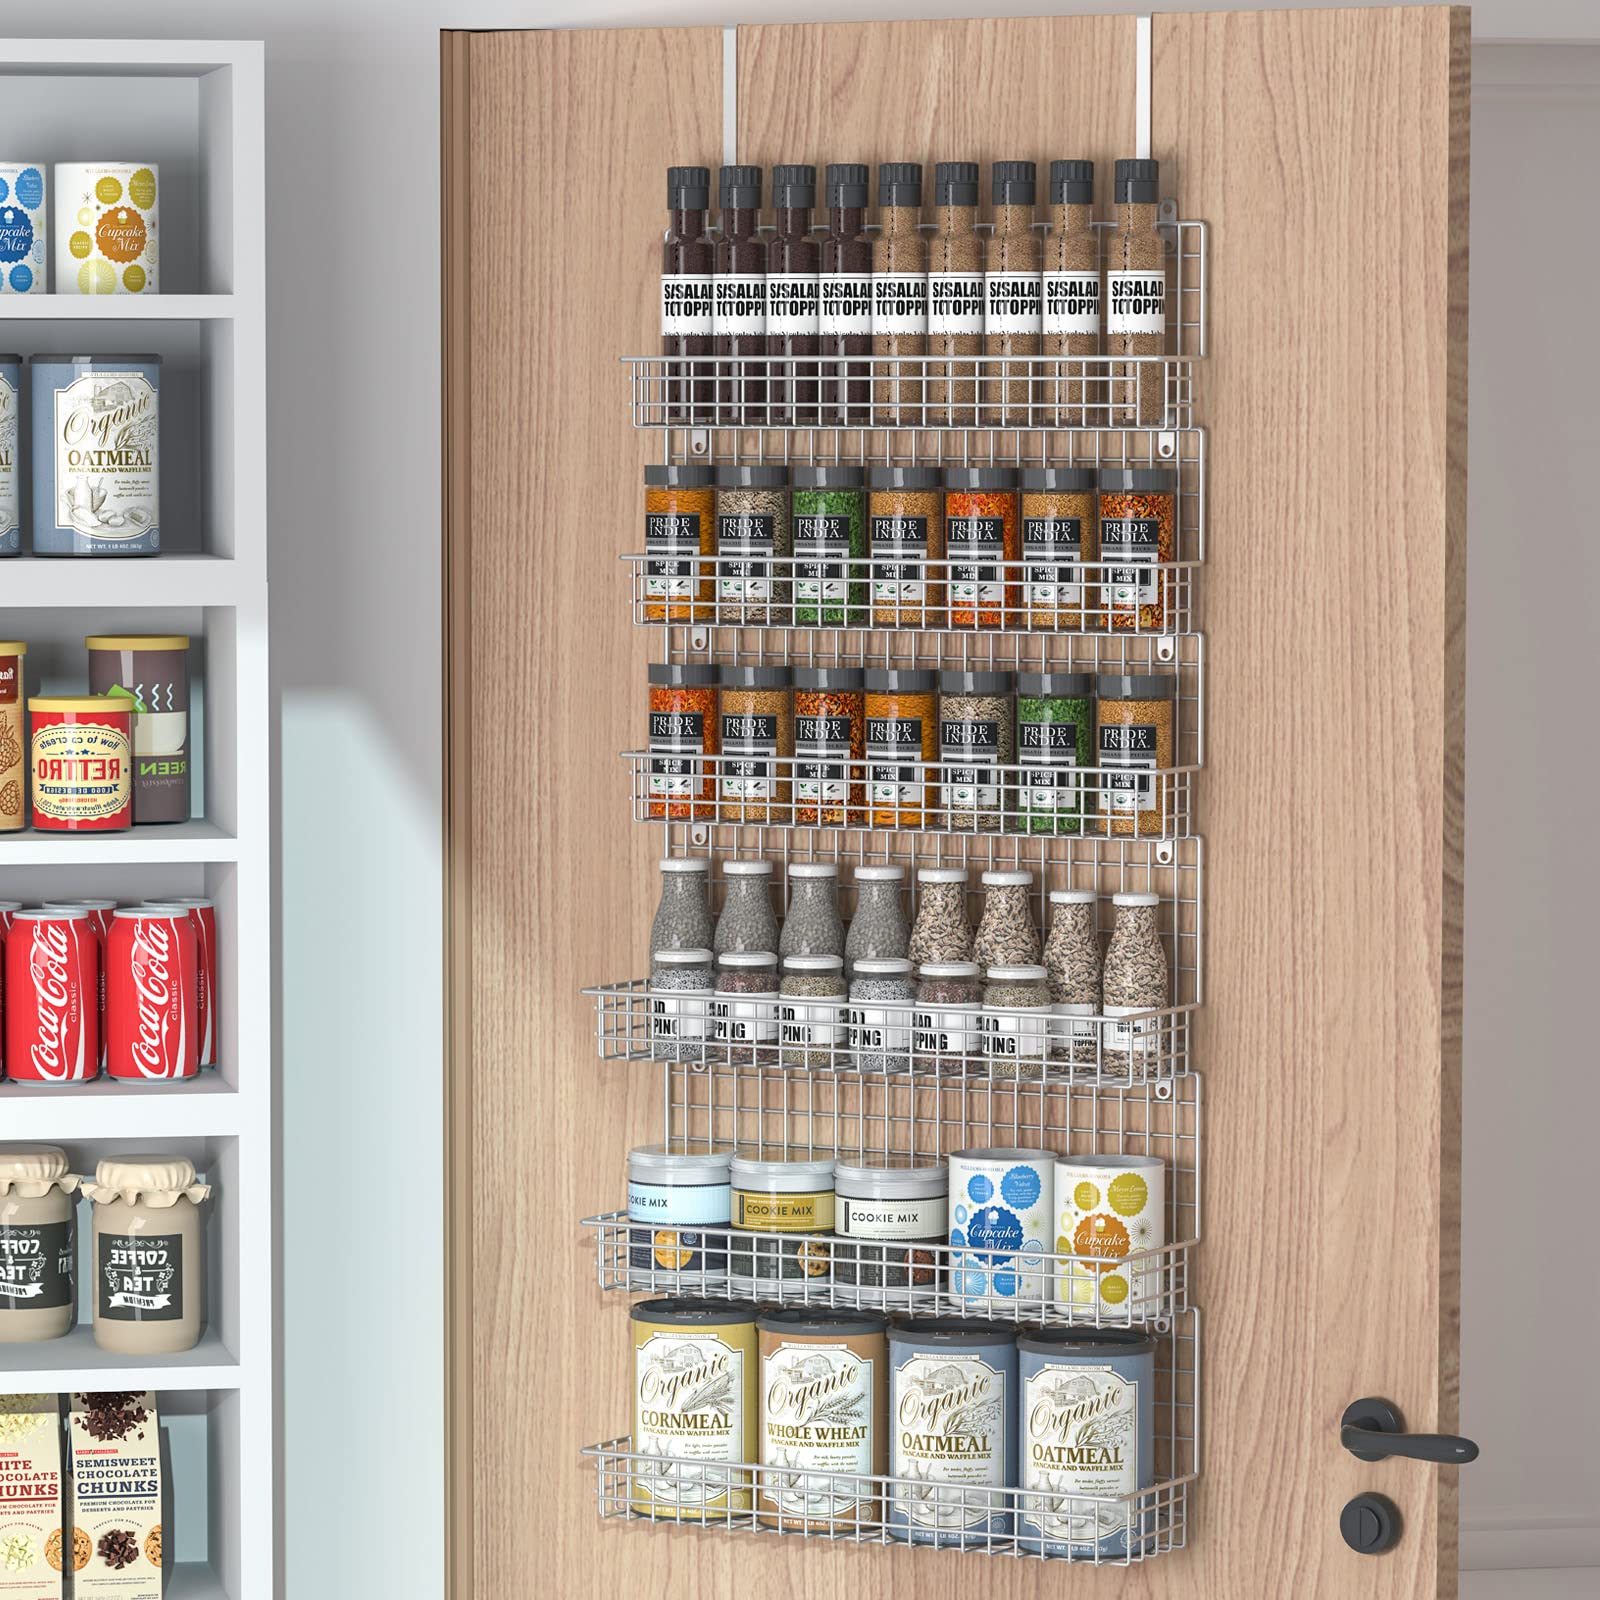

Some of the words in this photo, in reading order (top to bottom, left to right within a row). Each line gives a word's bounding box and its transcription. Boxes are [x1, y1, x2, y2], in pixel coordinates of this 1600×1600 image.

[98, 224, 144, 239] Cupcake
[112, 238, 140, 251] Mix
[63, 391, 150, 448] Organic
[68, 450, 152, 466] OATMEAL
[650, 517, 690, 526] PRIDE
[723, 518, 764, 528] PRIDE
[798, 519, 839, 528] PRIDE
[876, 520, 917, 529] PRIDE
[952, 521, 994, 531] PRIDE
[1028, 522, 1071, 532] PRIDE
[1106, 522, 1148, 532] PRIDE
[653, 716, 694, 726] PRIDE
[726, 718, 767, 728] PRIDE
[800, 720, 841, 730] PRIDE
[871, 722, 912, 732] PRIDE
[946, 724, 988, 735] PRIDE
[1024, 726, 1067, 737] PRIDE
[1104, 729, 1147, 739] PRIDE
[30, 923, 69, 1081] Coca-Cola
[131, 922, 169, 1079] Coca-Cola
[851, 1029, 881, 1046] PNG
[649, 1199, 668, 1208] MIX
[746, 1204, 788, 1216] COOKIE
[792, 1206, 813, 1216] MIX
[851, 1212, 894, 1223] COOKIE
[897, 1213, 919, 1223] MIX
[970, 1223, 1019, 1240] Cupcake
[1076, 1231, 1126, 1250] Cupcake
[640, 1353, 729, 1409] Organic
[767, 1363, 859, 1420] Organic
[899, 1374, 990, 1432] Organic
[641, 1409, 733, 1429] CORNMEAL
[1029, 1386, 1122, 1444] Organic
[767, 1422, 811, 1440] WHOLE
[814, 1425, 868, 1440] WHEAT
[798, 1440, 814, 1448] AND
[902, 1432, 992, 1452] OATMEAL
[1033, 1443, 1124, 1464] OATMEAL
[76, 1457, 156, 1468] SEMISWEET
[77, 1469, 158, 1480] CHOCOLATE
[77, 1480, 158, 1494] CHUNKS
